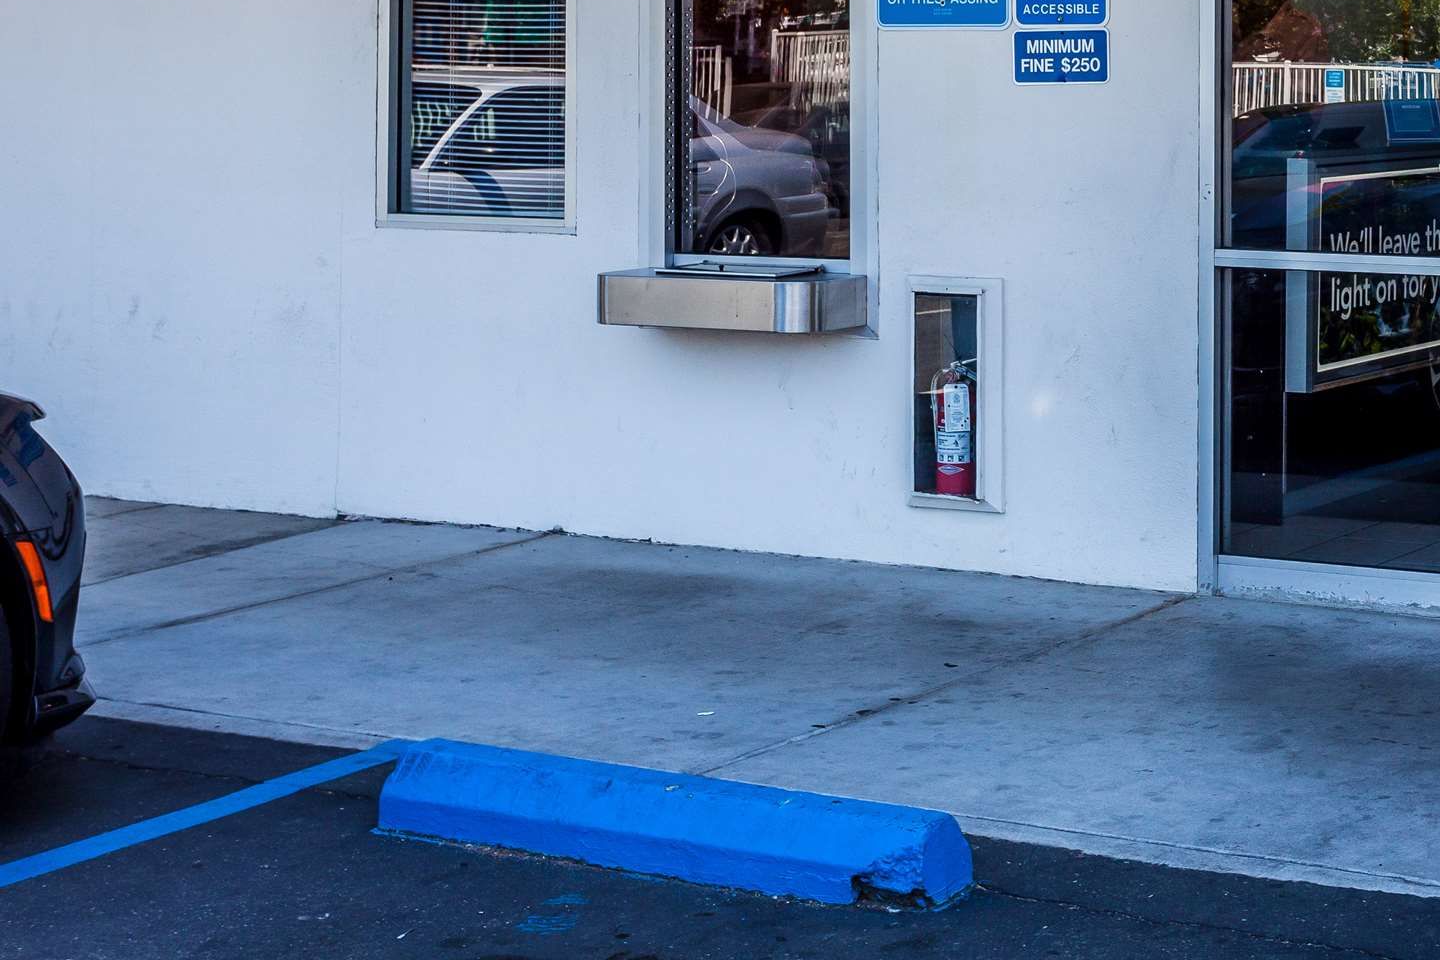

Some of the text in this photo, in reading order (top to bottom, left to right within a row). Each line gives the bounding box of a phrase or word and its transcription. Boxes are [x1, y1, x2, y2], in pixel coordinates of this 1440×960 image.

[1023, 4, 1100, 15] ACCESSIBLE
[1026, 39, 1095, 54] MINIMUM
[1021, 57, 1100, 73] FINE $250
[1330, 226, 1373, 253] We'll
[1379, 225, 1420, 254] leave
[1331, 274, 1370, 320] light
[1375, 279, 1397, 304] on
[1402, 275, 1426, 299] for
